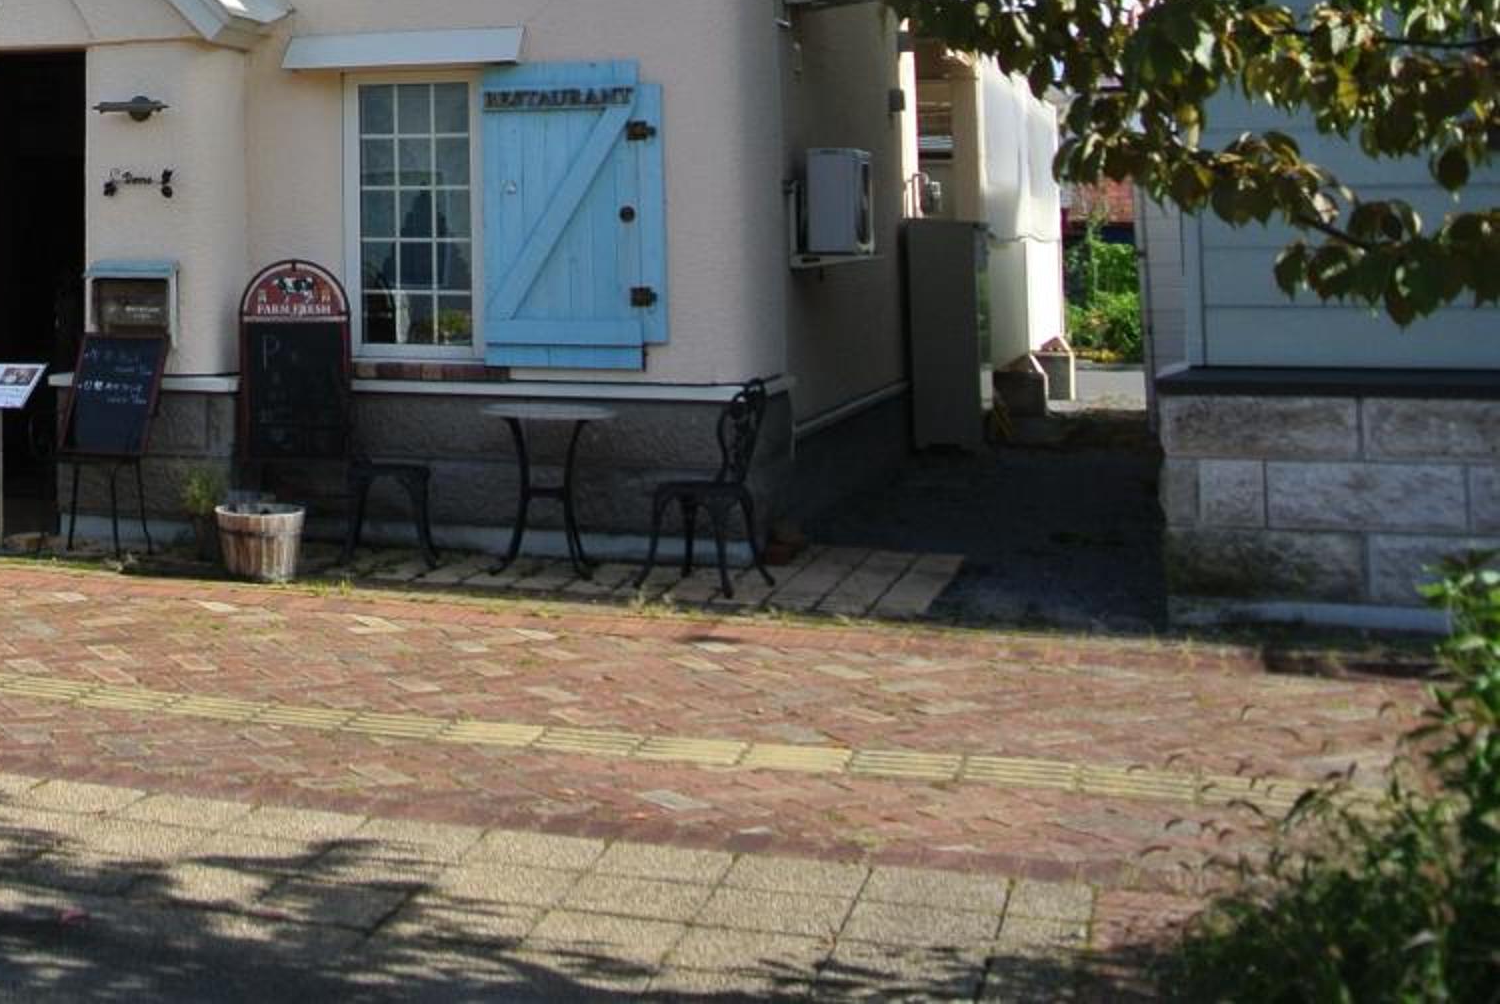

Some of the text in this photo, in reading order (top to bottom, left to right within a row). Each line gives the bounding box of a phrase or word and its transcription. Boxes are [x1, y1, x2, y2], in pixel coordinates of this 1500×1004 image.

[484, 86, 634, 110] RESTAURANT
[257, 304, 331, 316] FARM FRESH
